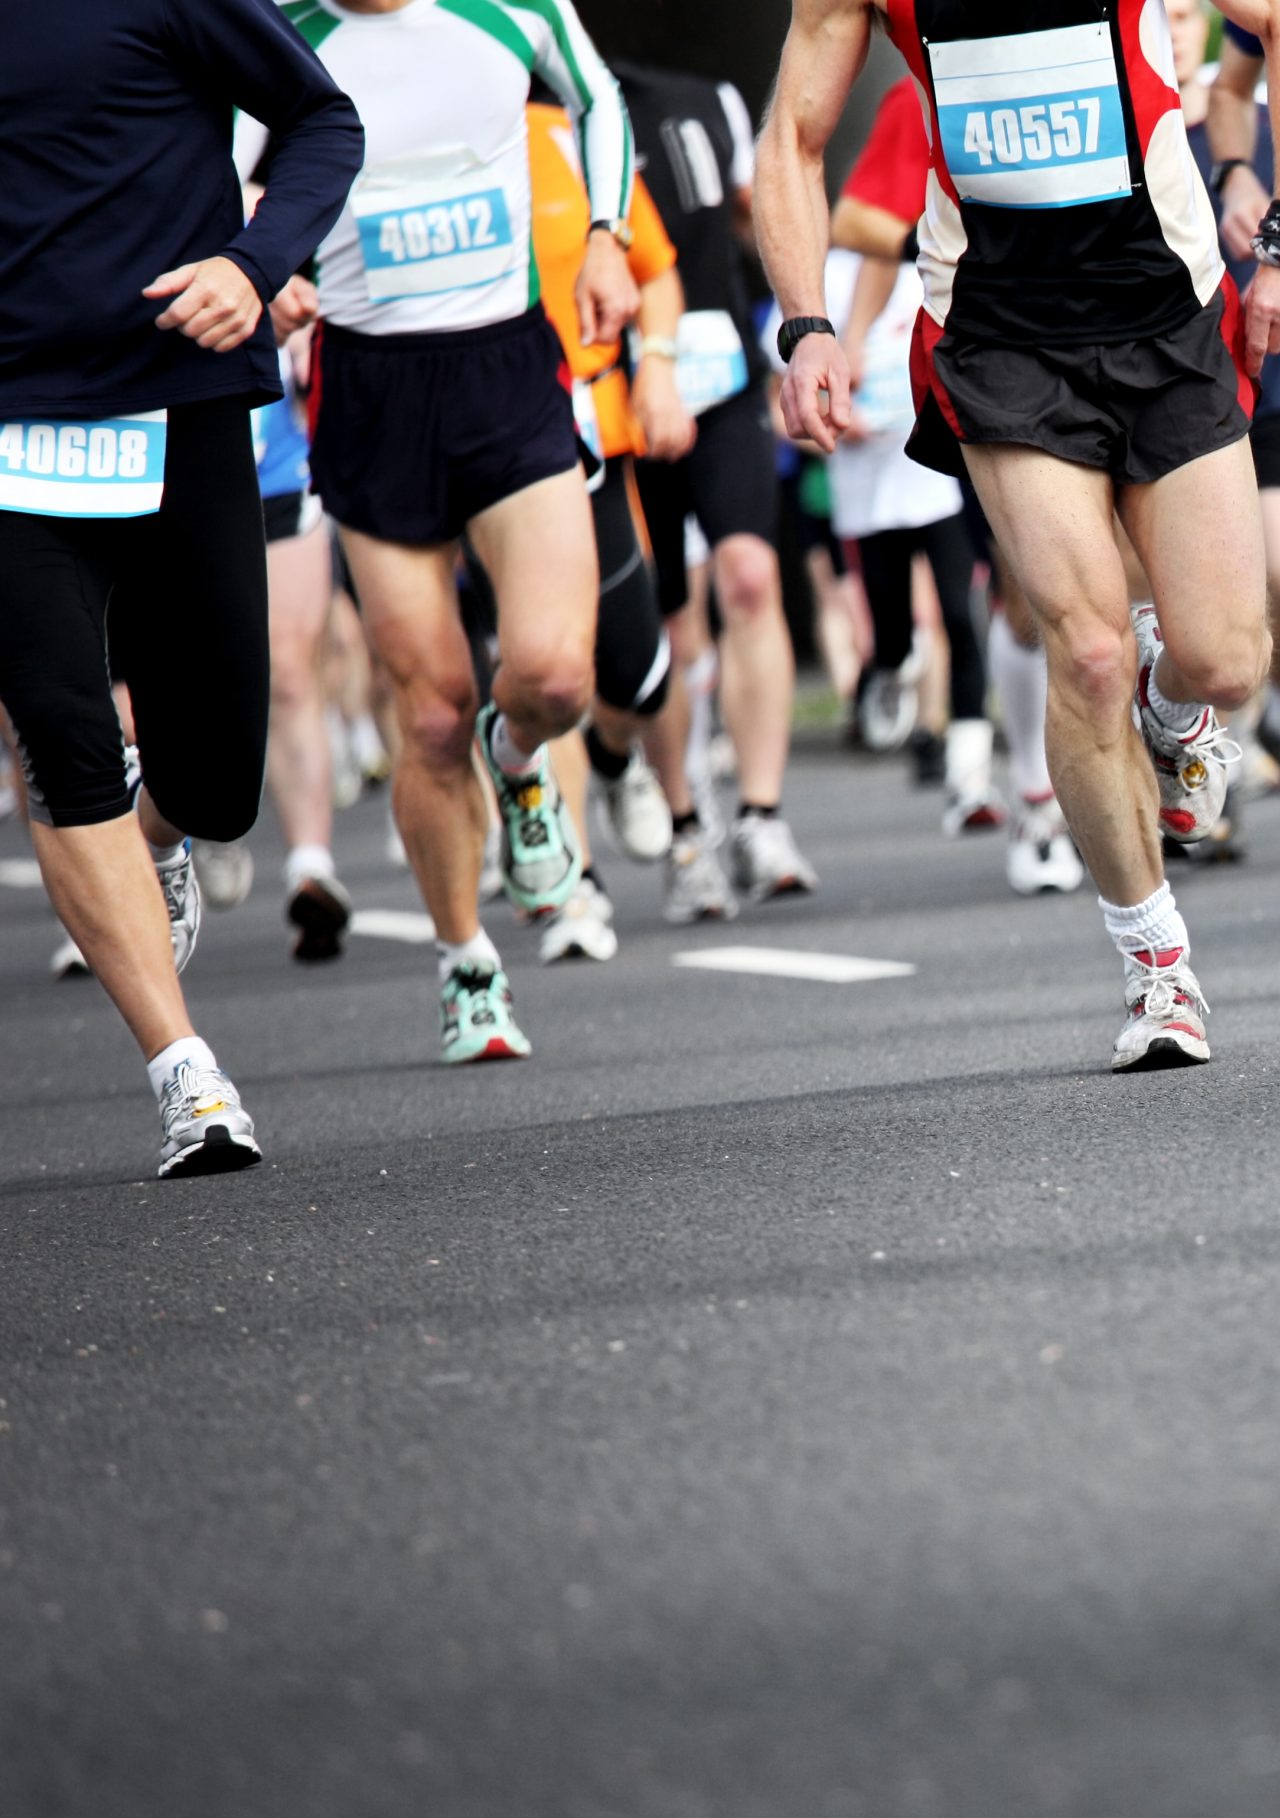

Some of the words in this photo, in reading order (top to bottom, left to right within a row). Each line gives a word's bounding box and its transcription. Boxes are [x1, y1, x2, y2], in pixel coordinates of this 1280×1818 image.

[964, 97, 1100, 166] 40557
[379, 197, 497, 262] 40312
[0, 424, 148, 478] 40608
